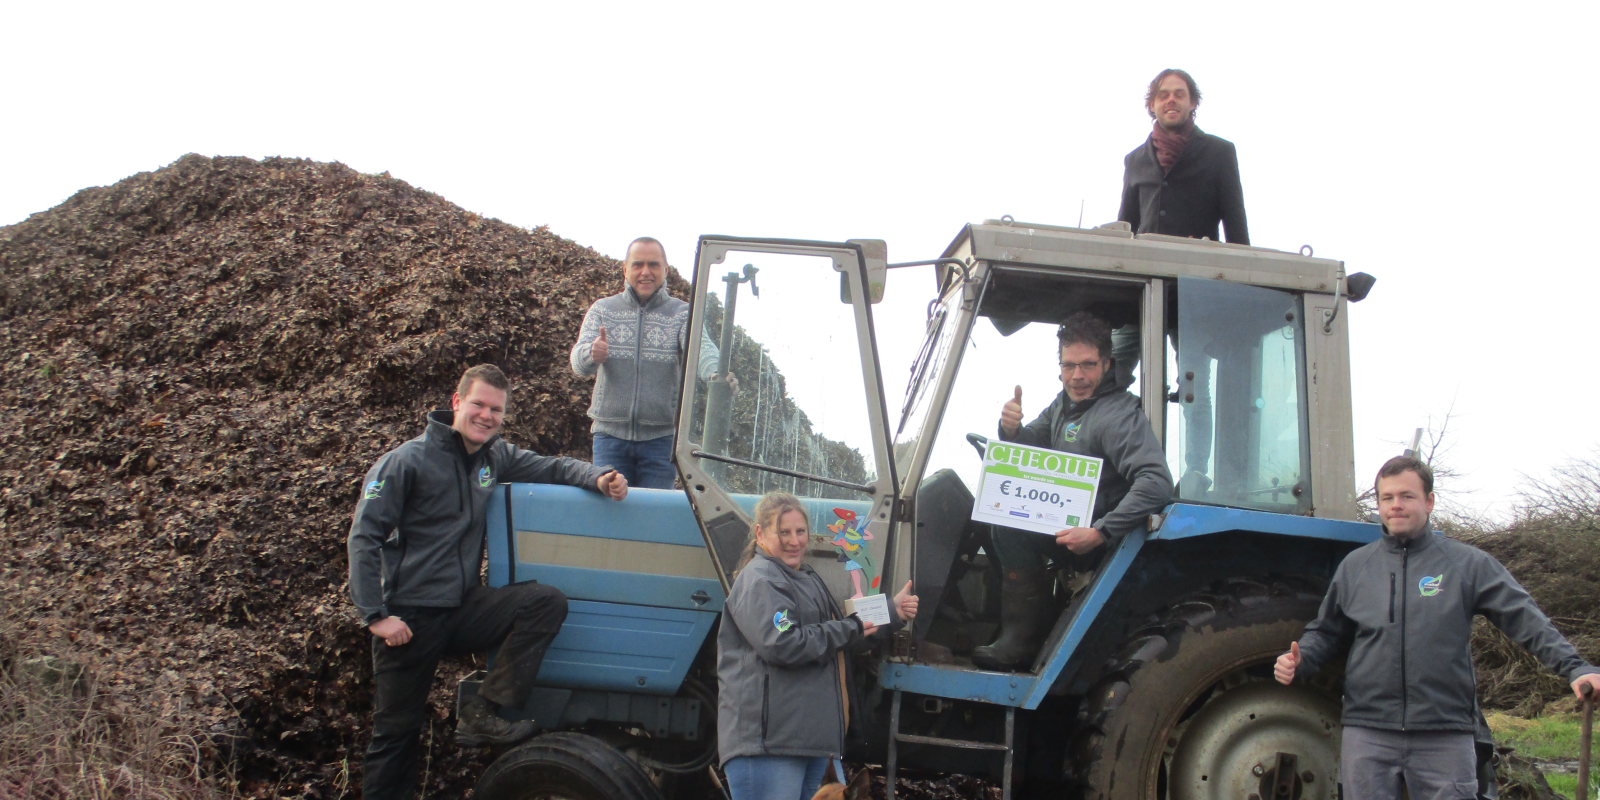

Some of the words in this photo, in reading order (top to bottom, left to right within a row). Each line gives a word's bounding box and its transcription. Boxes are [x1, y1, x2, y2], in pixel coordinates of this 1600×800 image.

[989, 445, 1098, 479] CHEQUE
[999, 480, 1012, 496] €
[1014, 486, 1072, 508] 1.000,-
